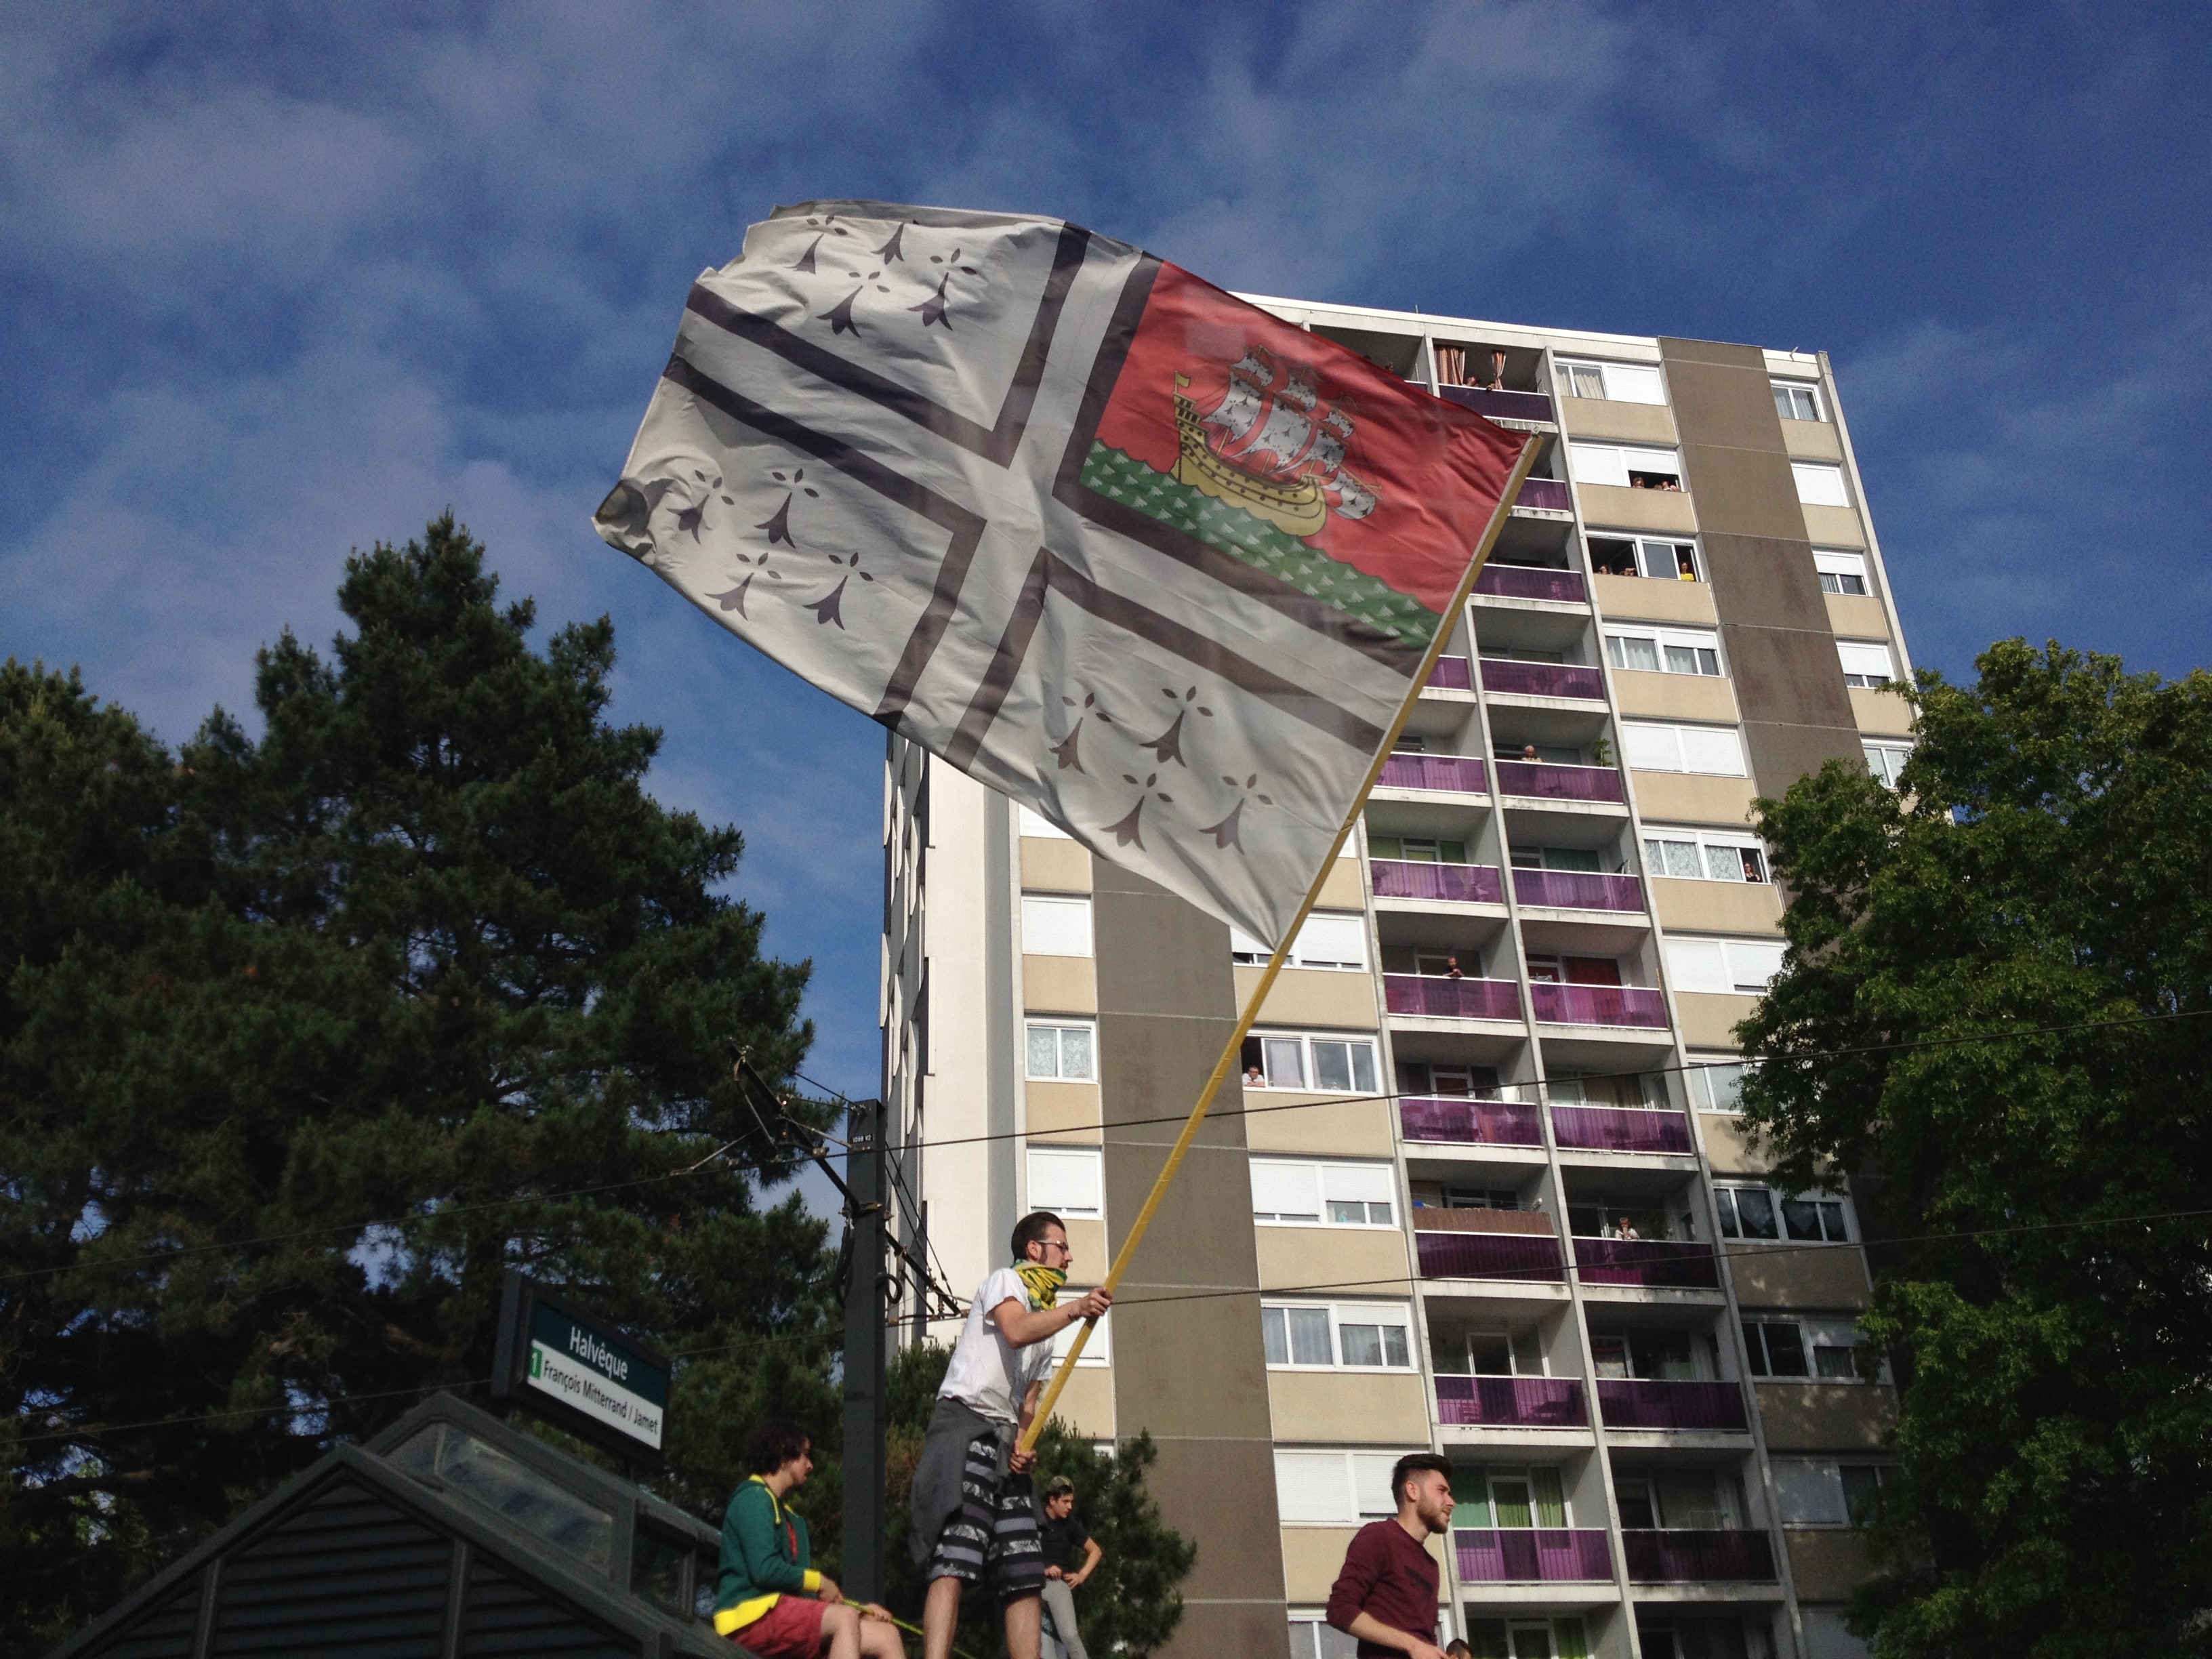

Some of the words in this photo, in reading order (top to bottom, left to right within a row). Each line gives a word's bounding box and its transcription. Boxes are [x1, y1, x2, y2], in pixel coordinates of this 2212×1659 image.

[569, 1326, 628, 1380] Halvêque
[532, 1353, 537, 1373] 1
[543, 1360, 581, 1393] François
[583, 1380, 627, 1419] Mitterrand
[628, 1406, 633, 1421] /
[634, 1409, 657, 1435] Jamet
